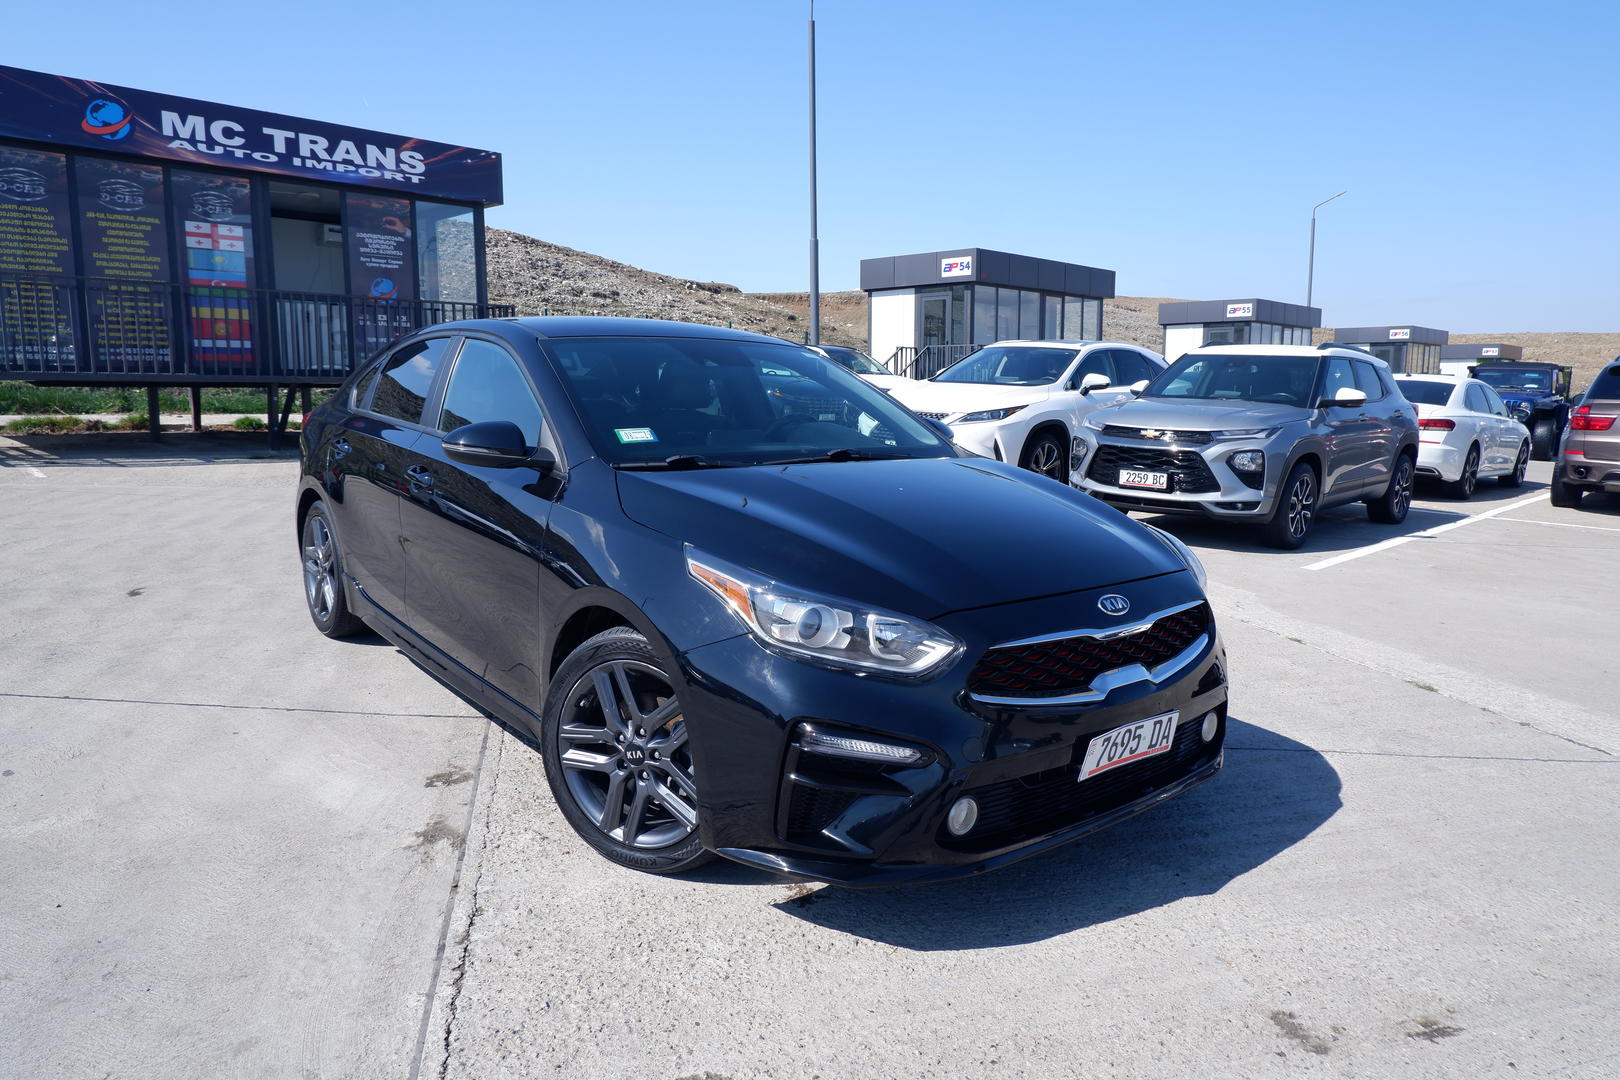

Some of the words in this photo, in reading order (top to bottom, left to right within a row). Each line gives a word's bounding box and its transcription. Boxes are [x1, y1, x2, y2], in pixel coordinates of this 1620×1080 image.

[161, 110, 246, 147] MC
[262, 126, 426, 174] TRANS
[168, 139, 279, 163] AUTO
[293, 157, 426, 185] IMPORT
[959, 261, 971, 271] 54
[1242, 306, 1251, 314] 55
[1126, 471, 1149, 485] 2259
[1153, 474, 1165, 486] BC
[1103, 597, 1128, 611] KIA
[1096, 724, 1145, 768] 7695
[1148, 716, 1173, 750] DA
[626, 750, 643, 759] KIA
